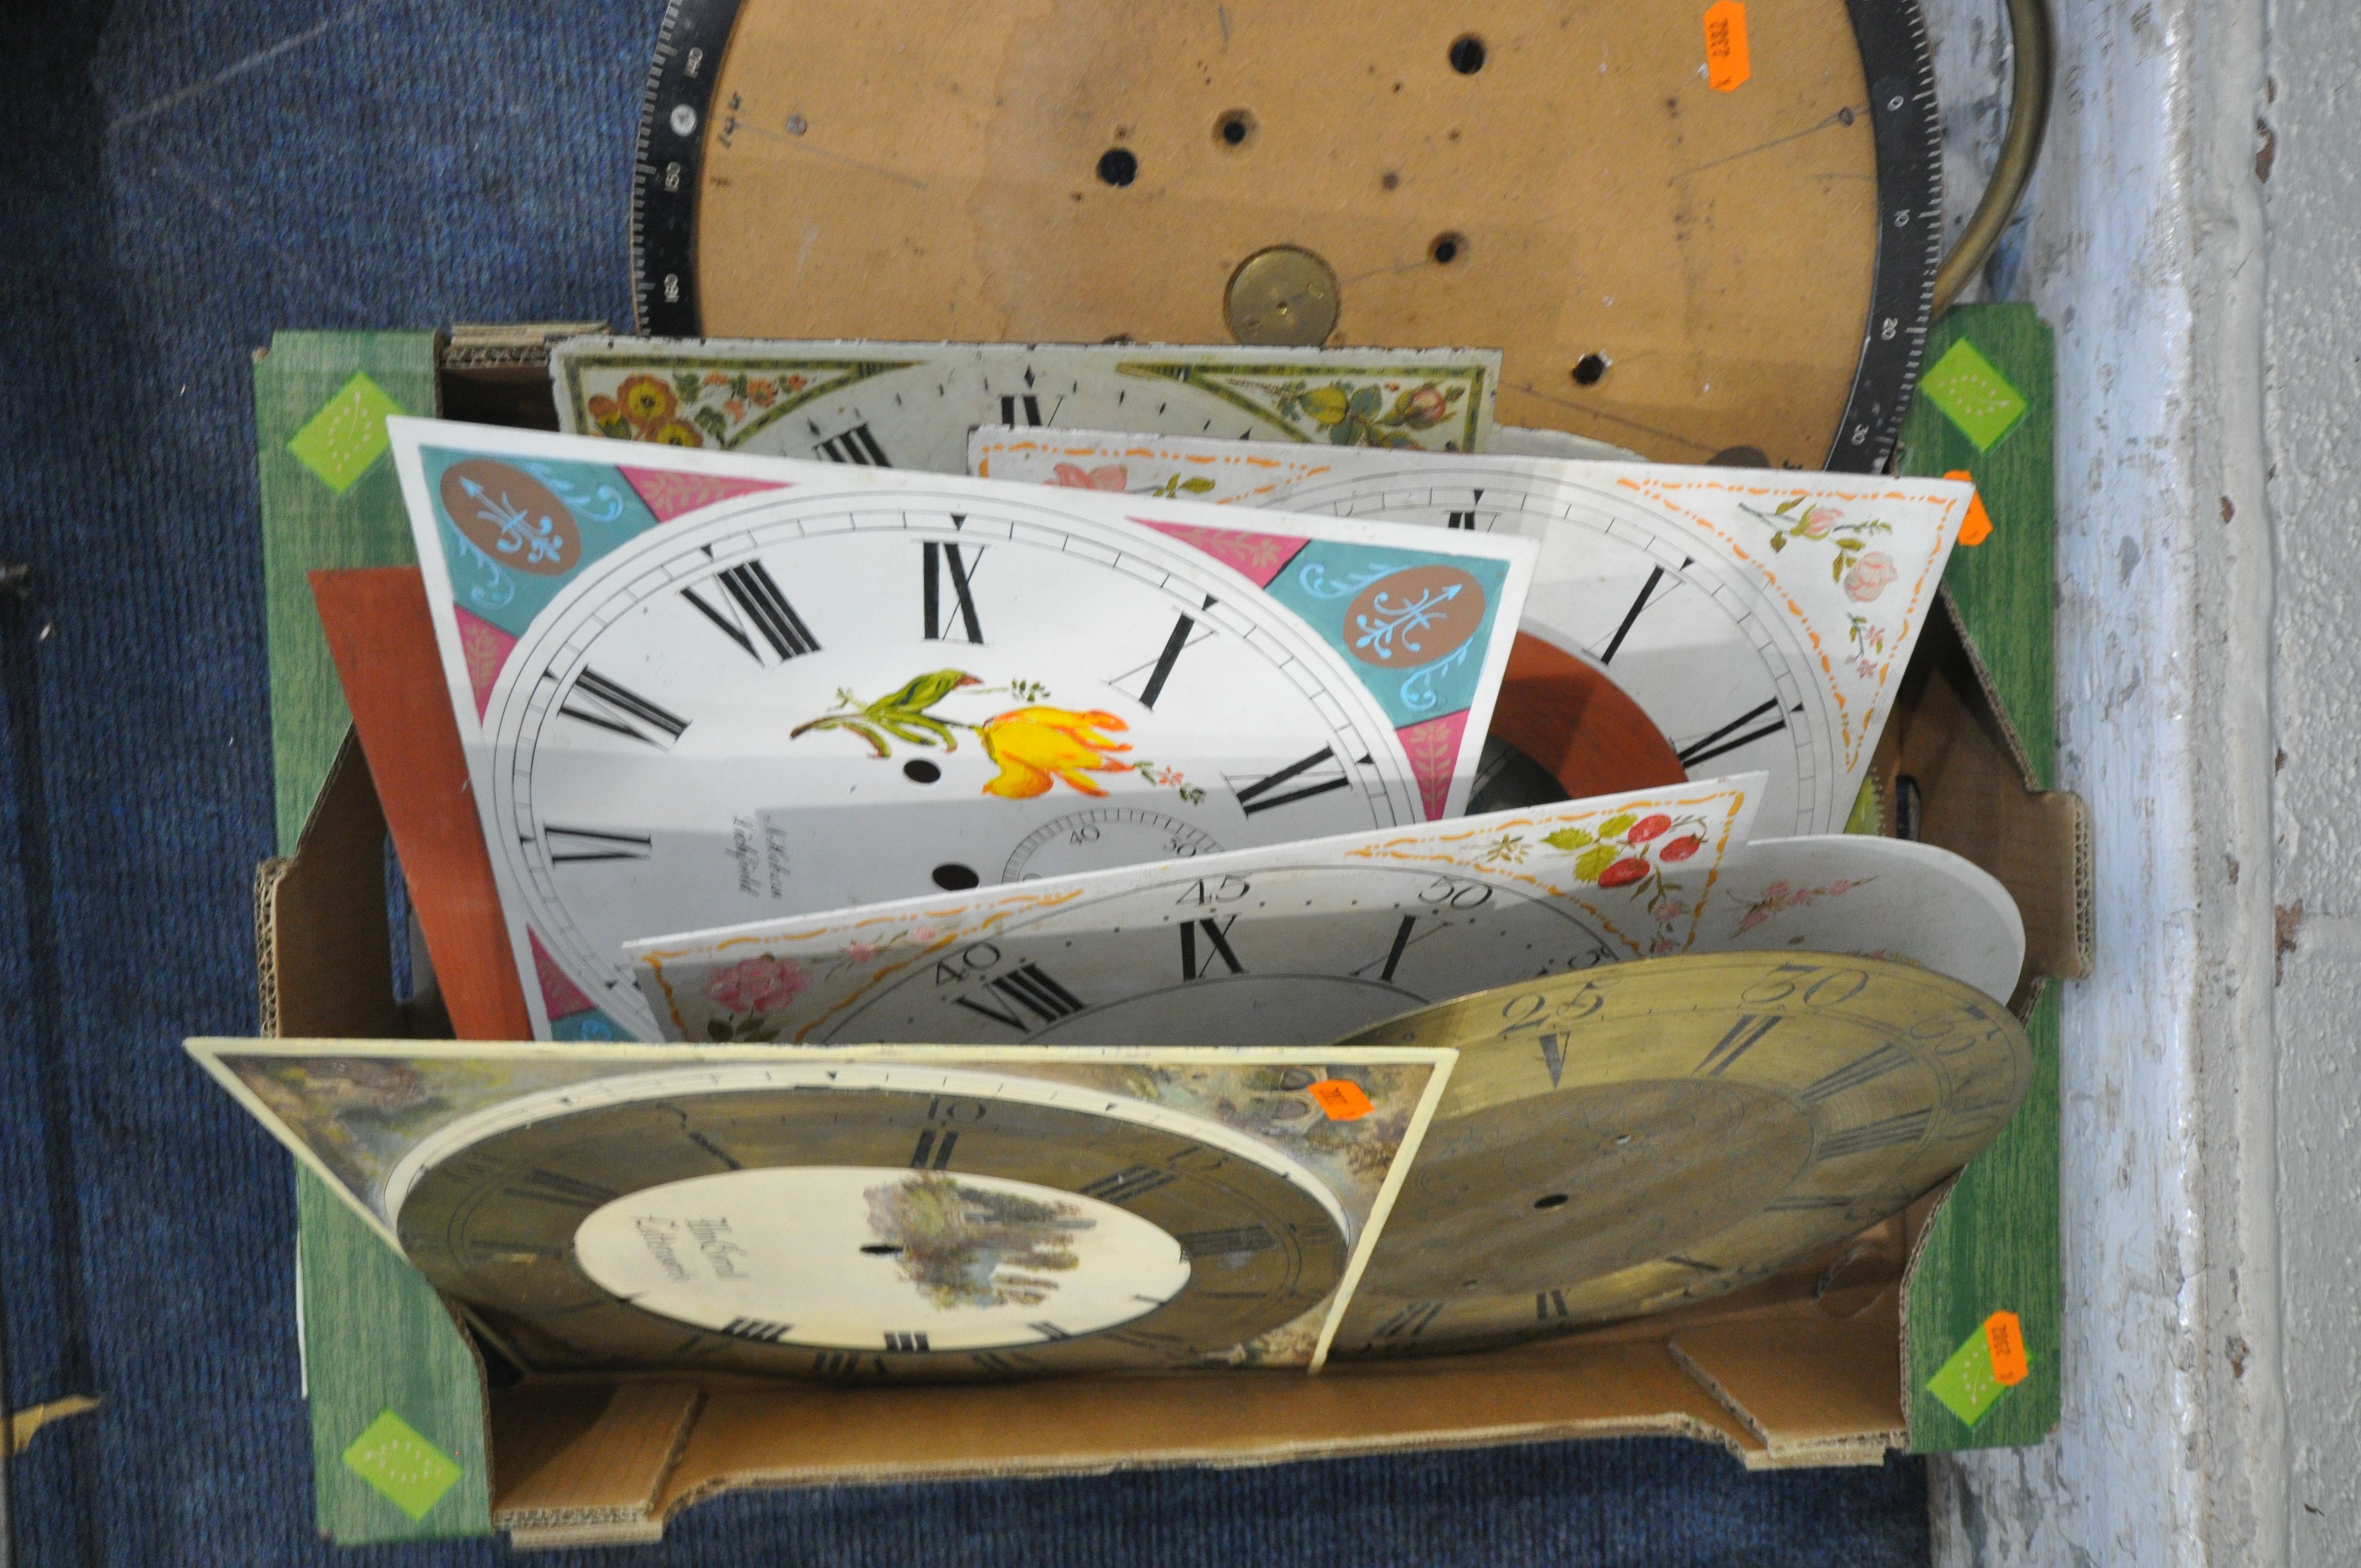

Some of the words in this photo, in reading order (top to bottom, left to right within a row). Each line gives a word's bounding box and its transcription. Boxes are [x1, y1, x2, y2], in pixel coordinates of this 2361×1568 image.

[1887, 96, 1904, 111] 0
[1894, 209, 1911, 227] 10
[1881, 317, 1898, 340] 20
[1851, 424, 1870, 445] 30
[678, 558, 823, 668] VIII
[918, 540, 989, 646] IX
[1581, 563, 1686, 666] X
[1100, 607, 1218, 714] X
[556, 663, 693, 753] VII
[1069, 825, 1101, 846] 40
[1163, 837, 1197, 857] 50
[1176, 874, 1252, 906] 45
[1418, 875, 1494, 910] 50
[936, 941, 1001, 984] 40
[1178, 912, 1247, 982] IX
[1350, 913, 1454, 982] X
[950, 961, 1094, 1035] VIII
[1497, 978, 1606, 1037] 25
[1739, 963, 1869, 1008] 30
